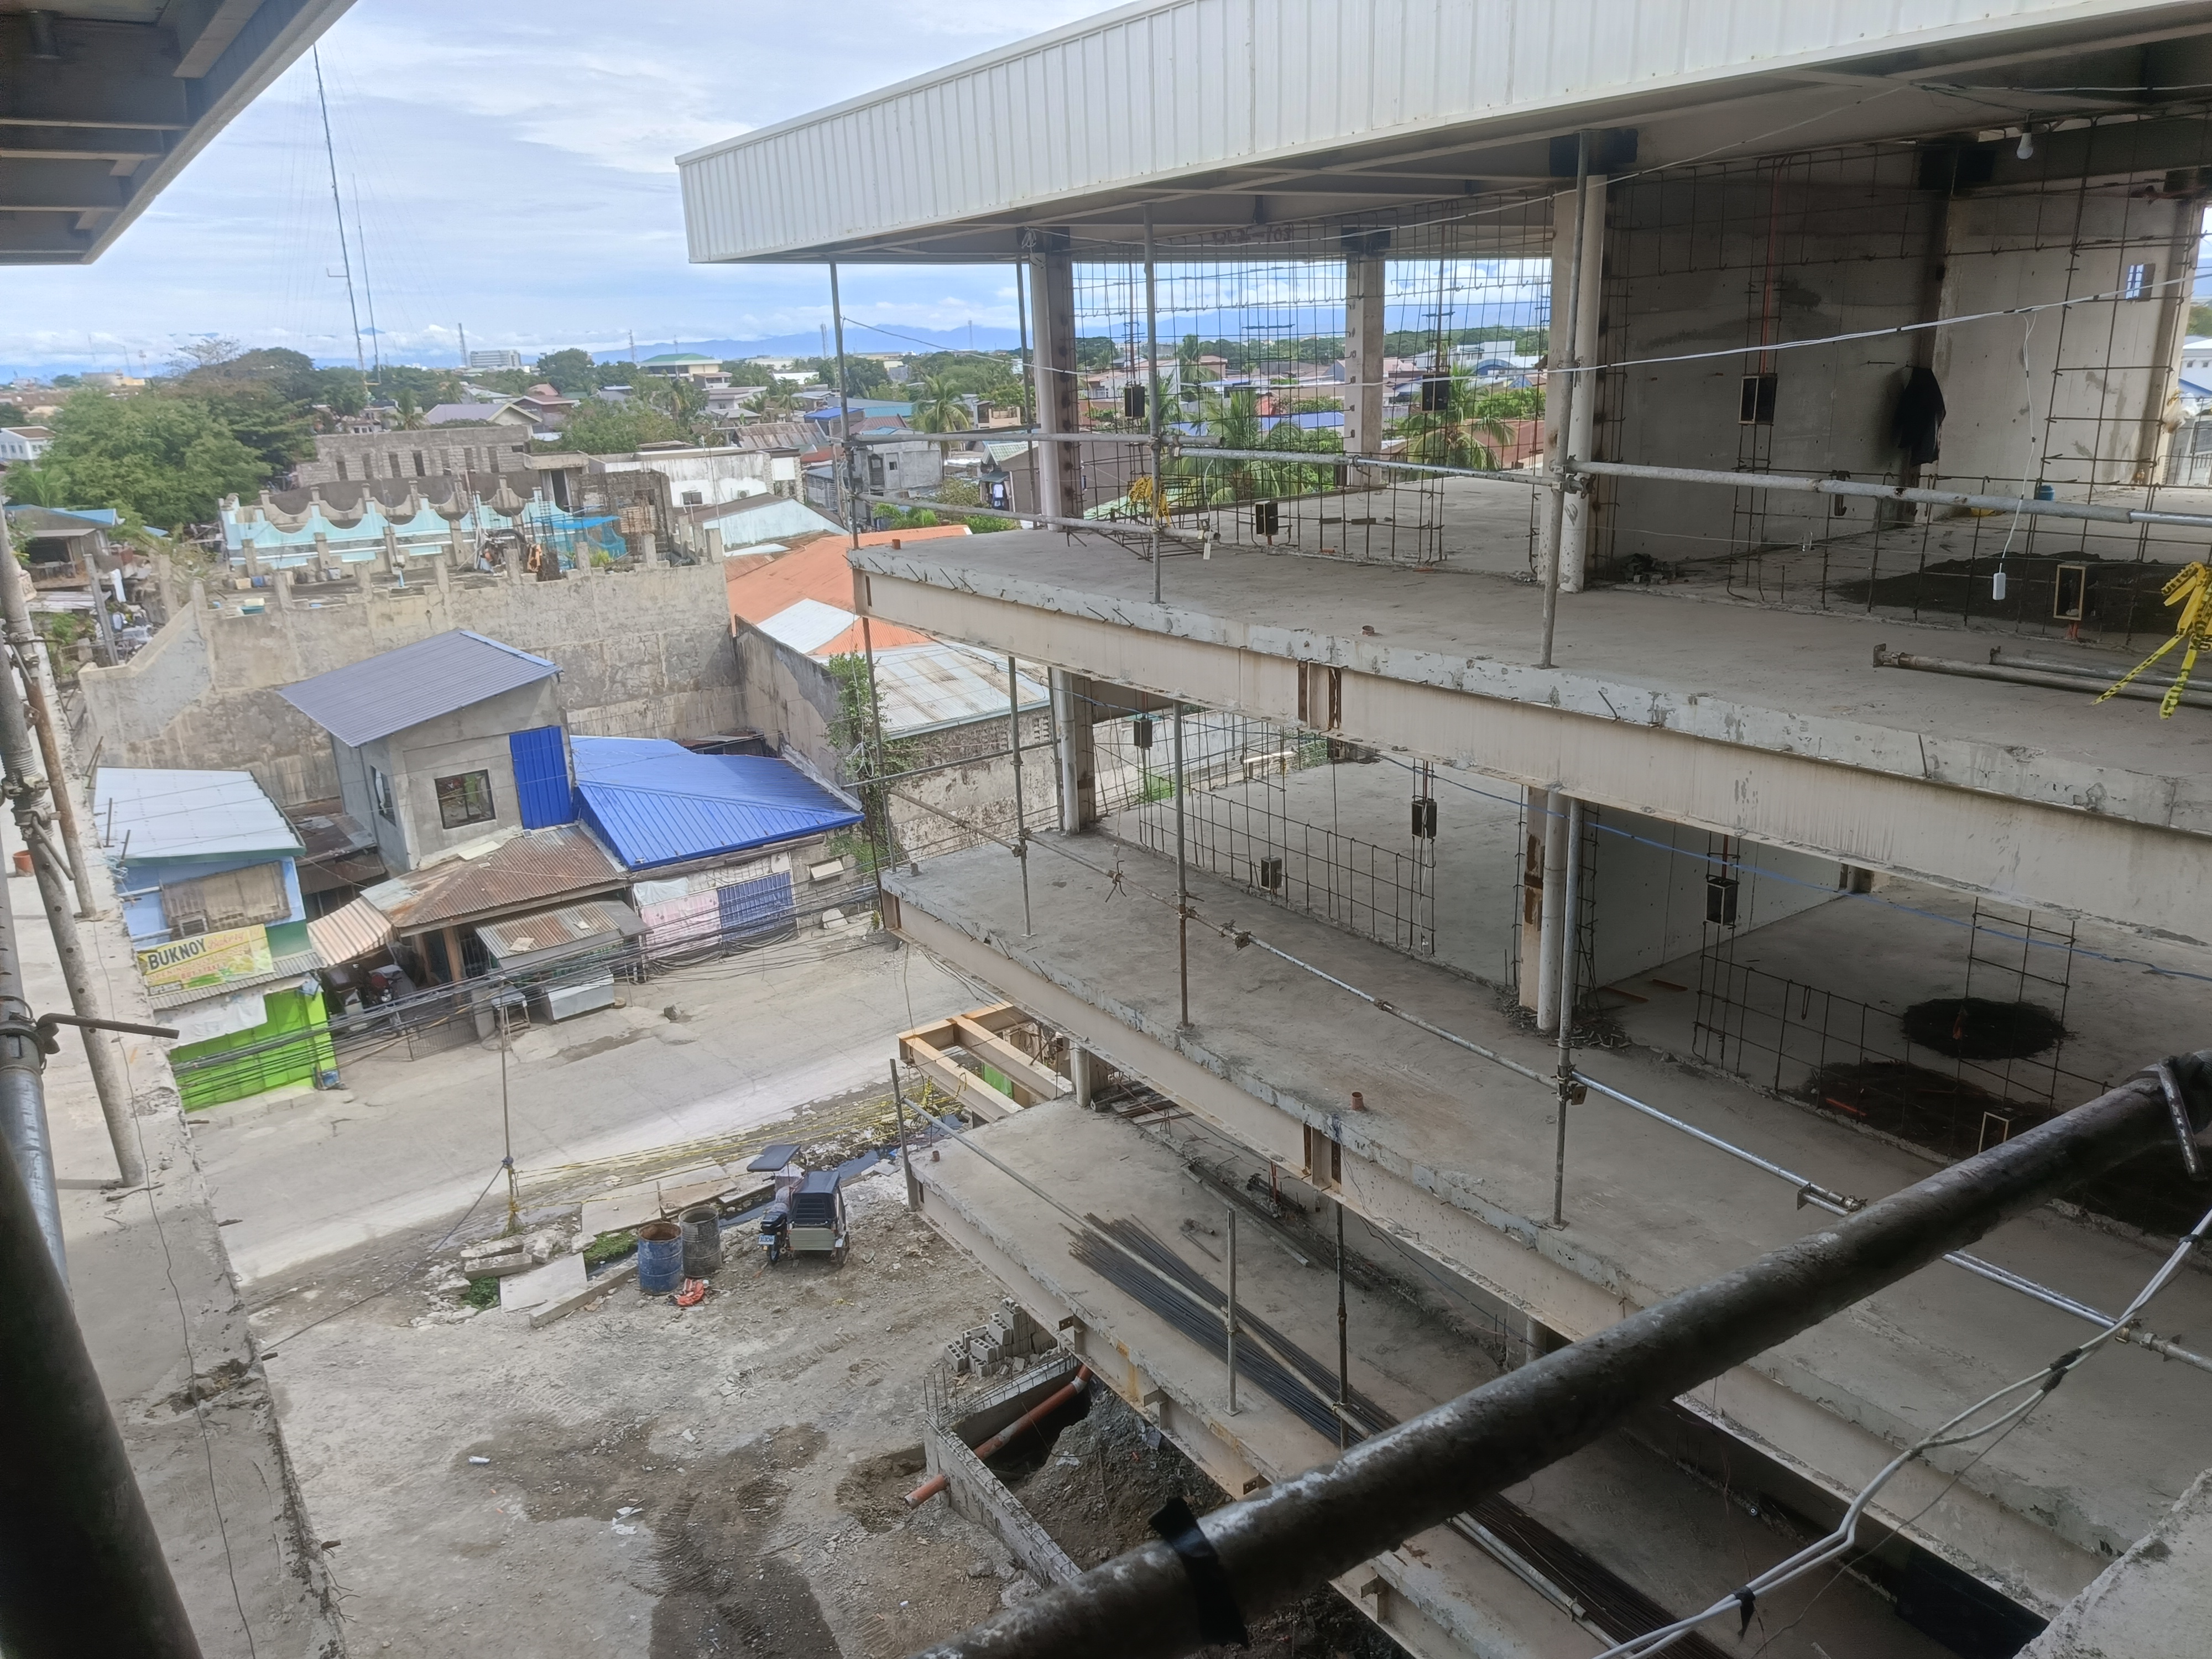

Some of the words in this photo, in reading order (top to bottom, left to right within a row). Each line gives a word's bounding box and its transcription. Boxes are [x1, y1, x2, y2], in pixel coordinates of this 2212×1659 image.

[148, 938, 206, 970] BUKNOY
[207, 932, 244, 949] Bakery
[149, 963, 188, 981] OPENING
